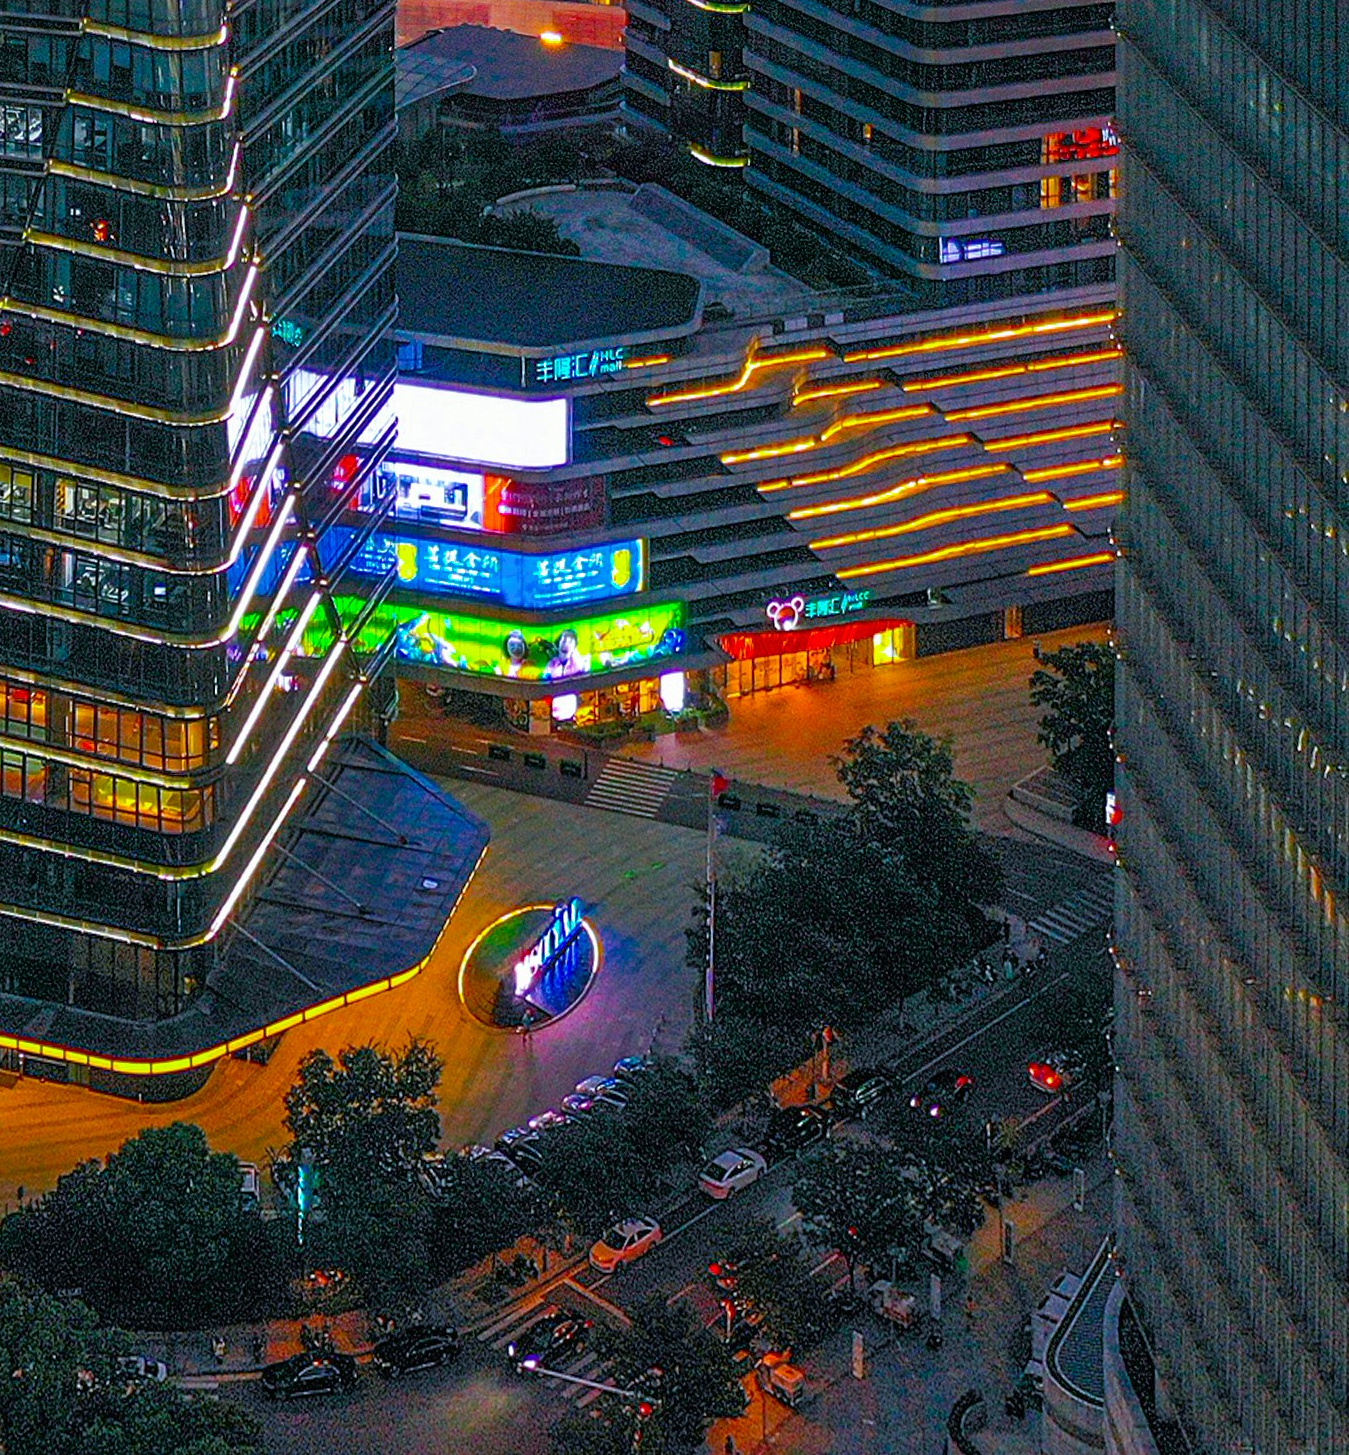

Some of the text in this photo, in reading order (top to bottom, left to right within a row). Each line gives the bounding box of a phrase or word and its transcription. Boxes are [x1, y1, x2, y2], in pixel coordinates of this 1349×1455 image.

[536, 354, 588, 383] 丰隆汇
[600, 360, 622, 374] mall
